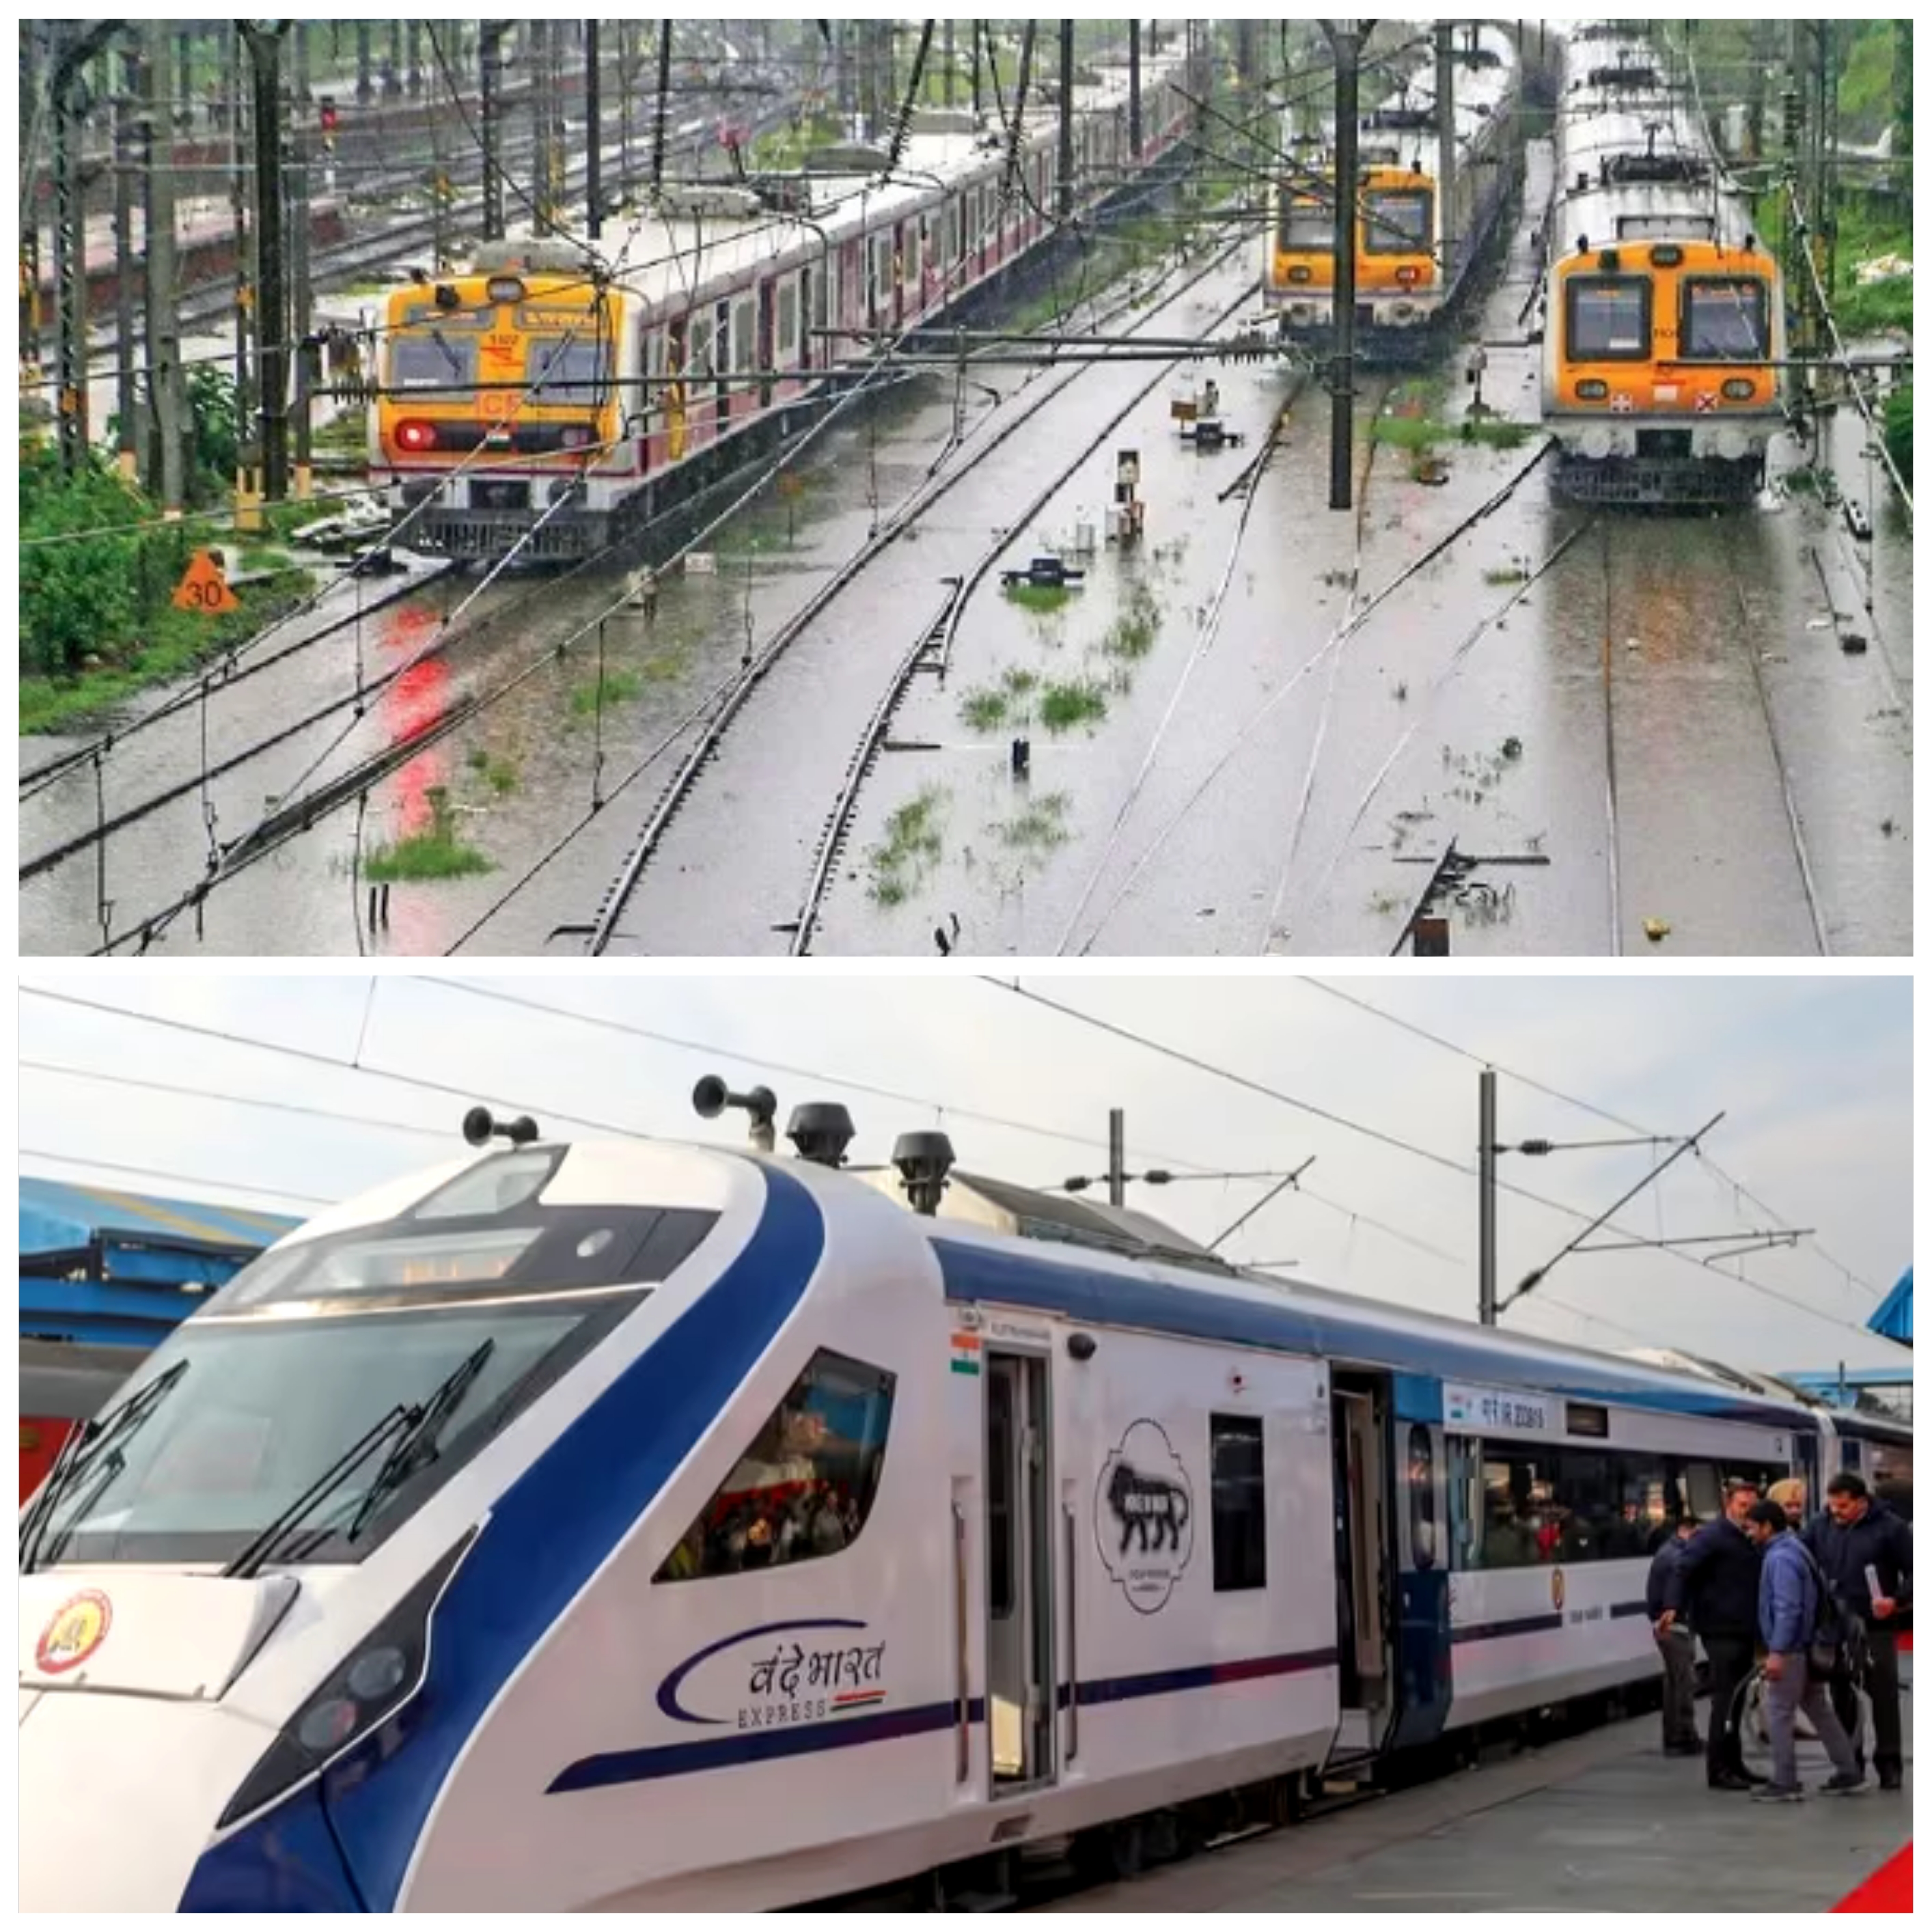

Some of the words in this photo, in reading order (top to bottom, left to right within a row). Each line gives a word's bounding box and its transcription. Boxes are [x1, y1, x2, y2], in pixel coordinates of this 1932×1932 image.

[186, 580, 221, 607] 30
[749, 1642, 805, 1699] वंदे
[808, 1640, 885, 1687] भारत
[738, 1700, 825, 1729] EXPRESS
